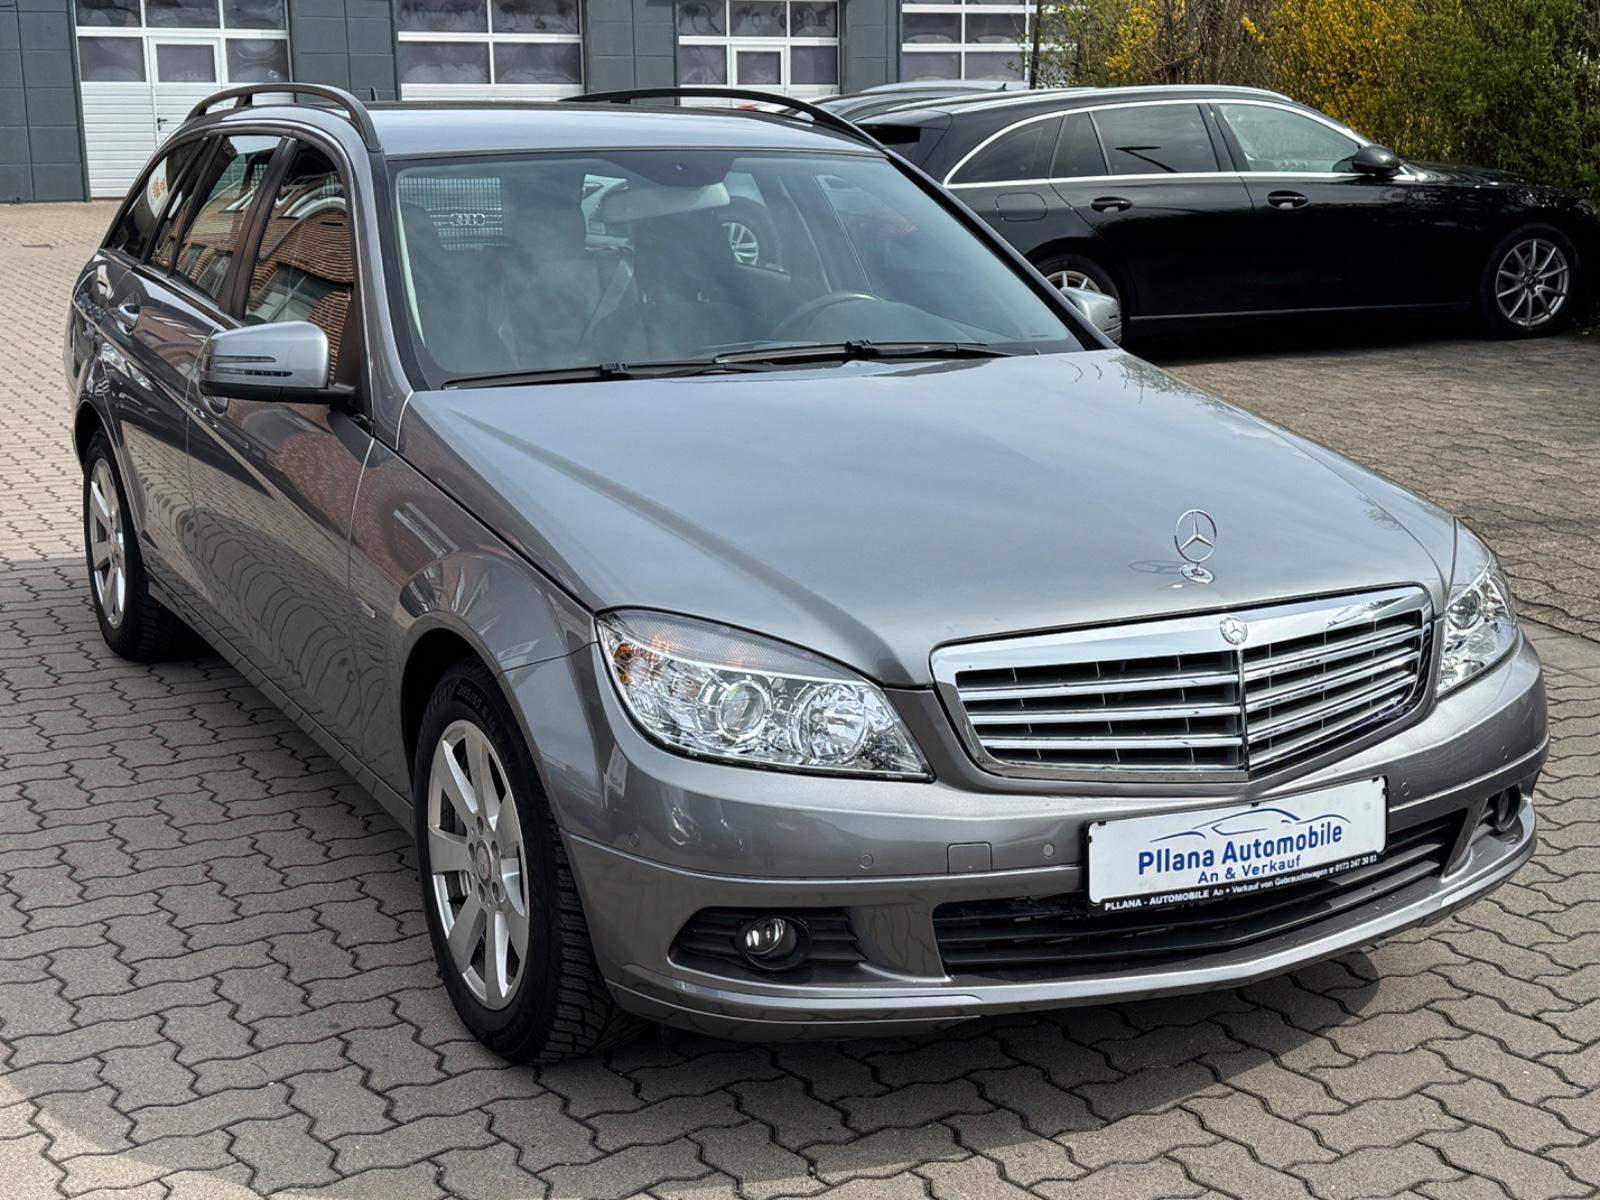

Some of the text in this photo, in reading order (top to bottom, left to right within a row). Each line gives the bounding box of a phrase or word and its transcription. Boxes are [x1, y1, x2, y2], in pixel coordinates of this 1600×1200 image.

[1138, 821, 1342, 875] Pllana Automobile
[1198, 855, 1301, 884] An & Verkauf
[1105, 898, 1142, 911] PLLANA
[1149, 890, 1210, 906] AUTOMOBILE
[1213, 888, 1224, 897] An
[1232, 881, 1260, 893] Verkauf
[1261, 880, 1274, 889] von
